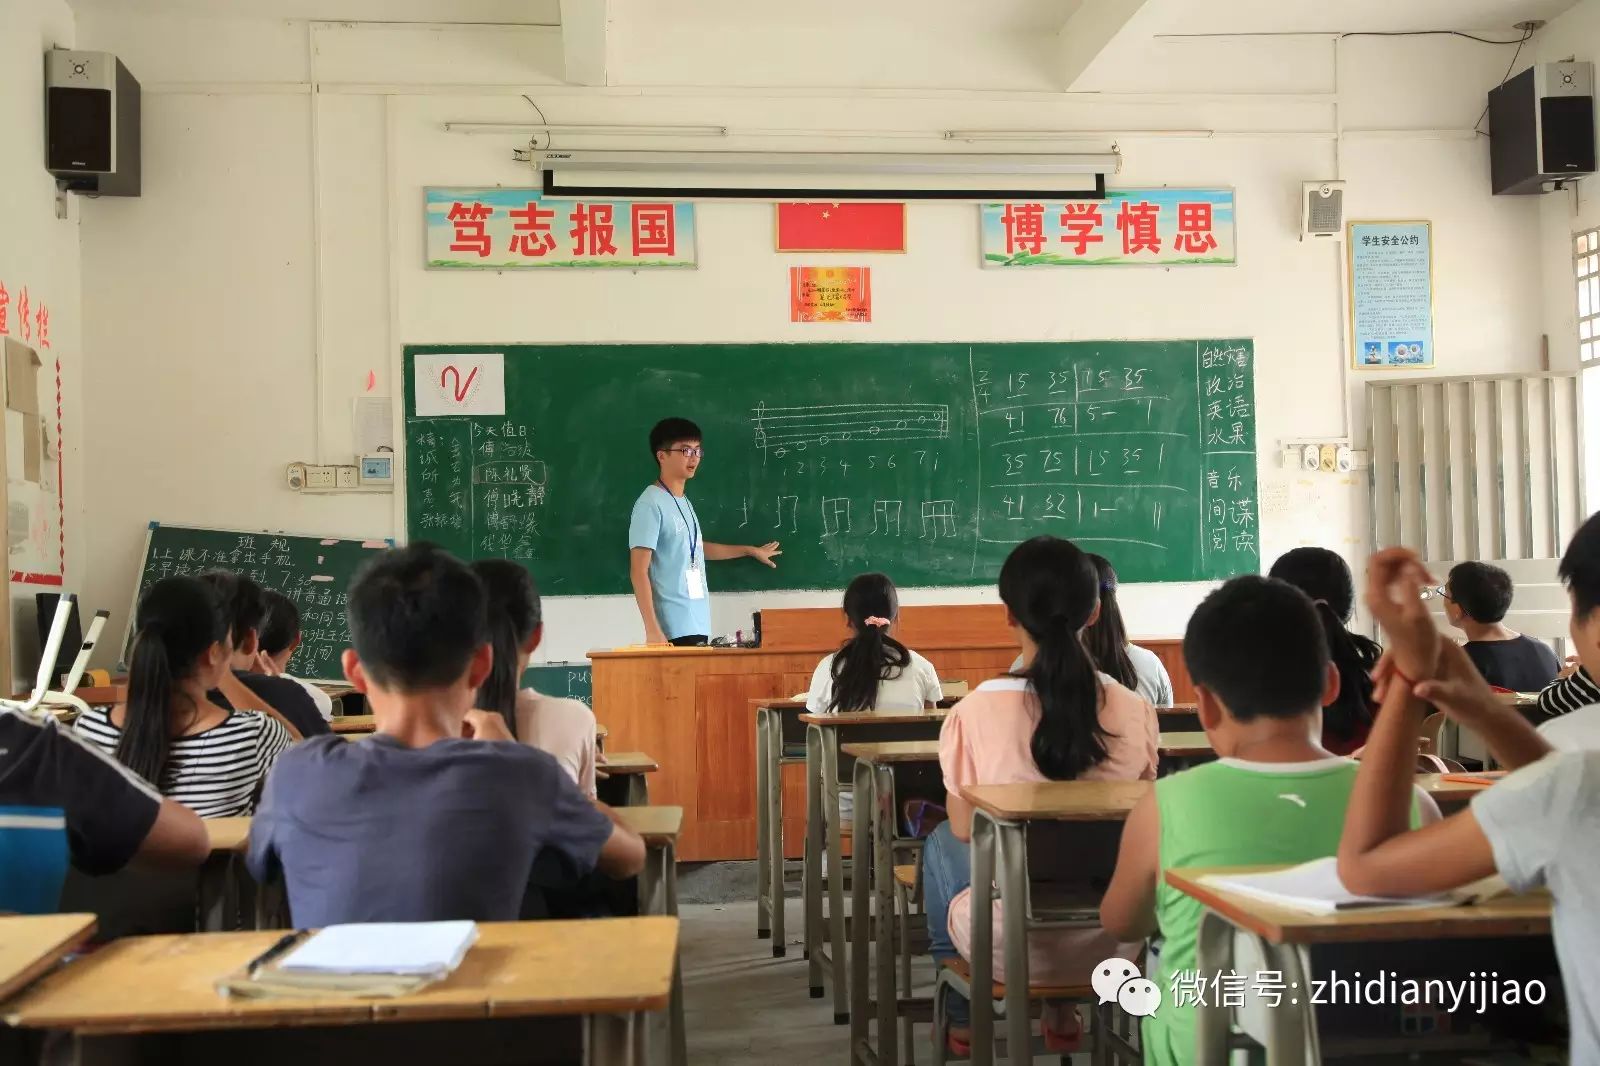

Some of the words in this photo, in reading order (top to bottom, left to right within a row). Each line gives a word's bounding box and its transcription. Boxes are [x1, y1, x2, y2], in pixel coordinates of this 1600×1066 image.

[447, 202, 676, 258] 笃志报国
[1001, 201, 1218, 256] 博学慎思
[1361, 234, 1420, 247] 学生安全公约
[1206, 372, 1244, 396] 政治
[1206, 397, 1250, 421] 英语
[1207, 422, 1246, 445] 水果
[797, 461, 805, 474] 2
[839, 456, 852, 477] 4
[867, 455, 878, 469] 5
[887, 454, 896, 469] 6
[913, 450, 926, 465] 7
[1206, 466, 1243, 491] 音乐
[237, 535, 291, 553] 班规
